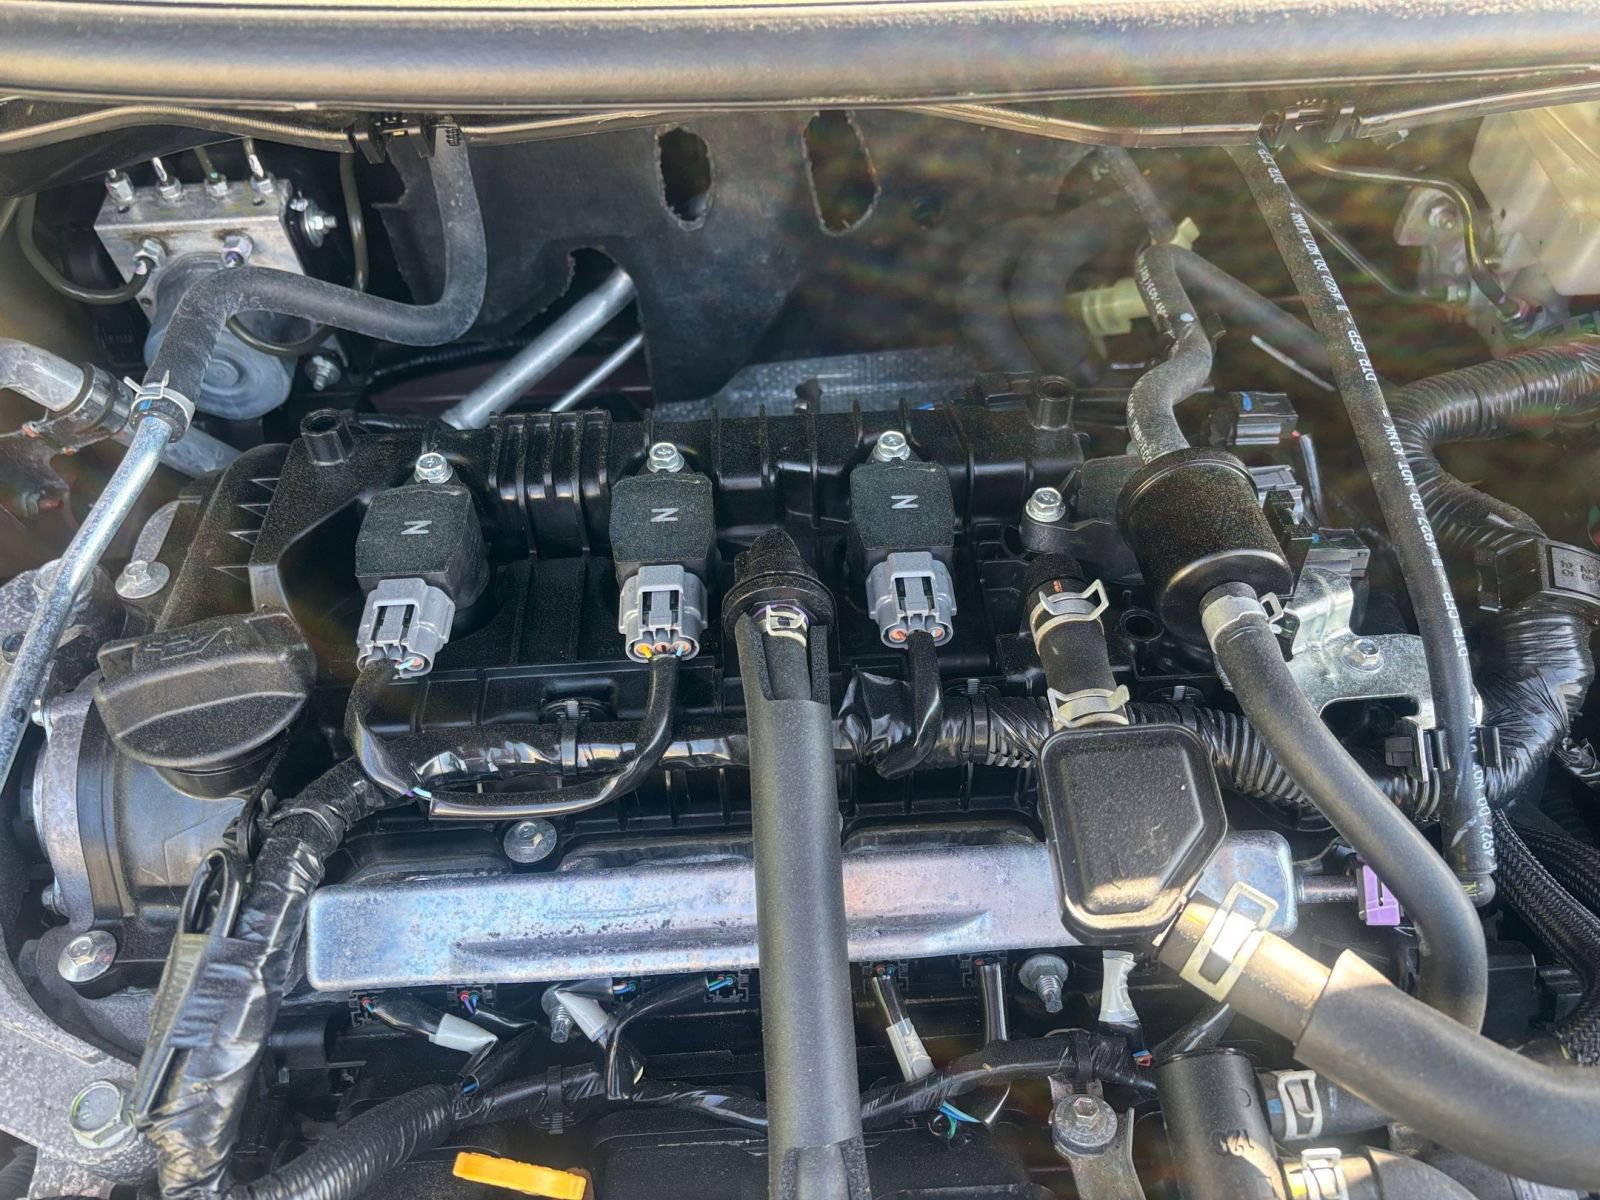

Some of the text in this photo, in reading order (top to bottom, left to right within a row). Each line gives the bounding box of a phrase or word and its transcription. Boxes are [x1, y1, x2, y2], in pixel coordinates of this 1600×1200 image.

[1302, 237, 1322, 256] NOT
[1313, 258, 1330, 271] DO
[1358, 358, 1378, 381] DTR
[1383, 422, 1406, 456] KINK
[1397, 461, 1417, 487] NOT
[1409, 492, 1425, 511] DO
[1417, 516, 1438, 550] 4927
[1452, 627, 1469, 657] DTR
[1471, 762, 1485, 791] NOT
[1476, 796, 1492, 817] DO
[1482, 824, 1495, 858] 4927
